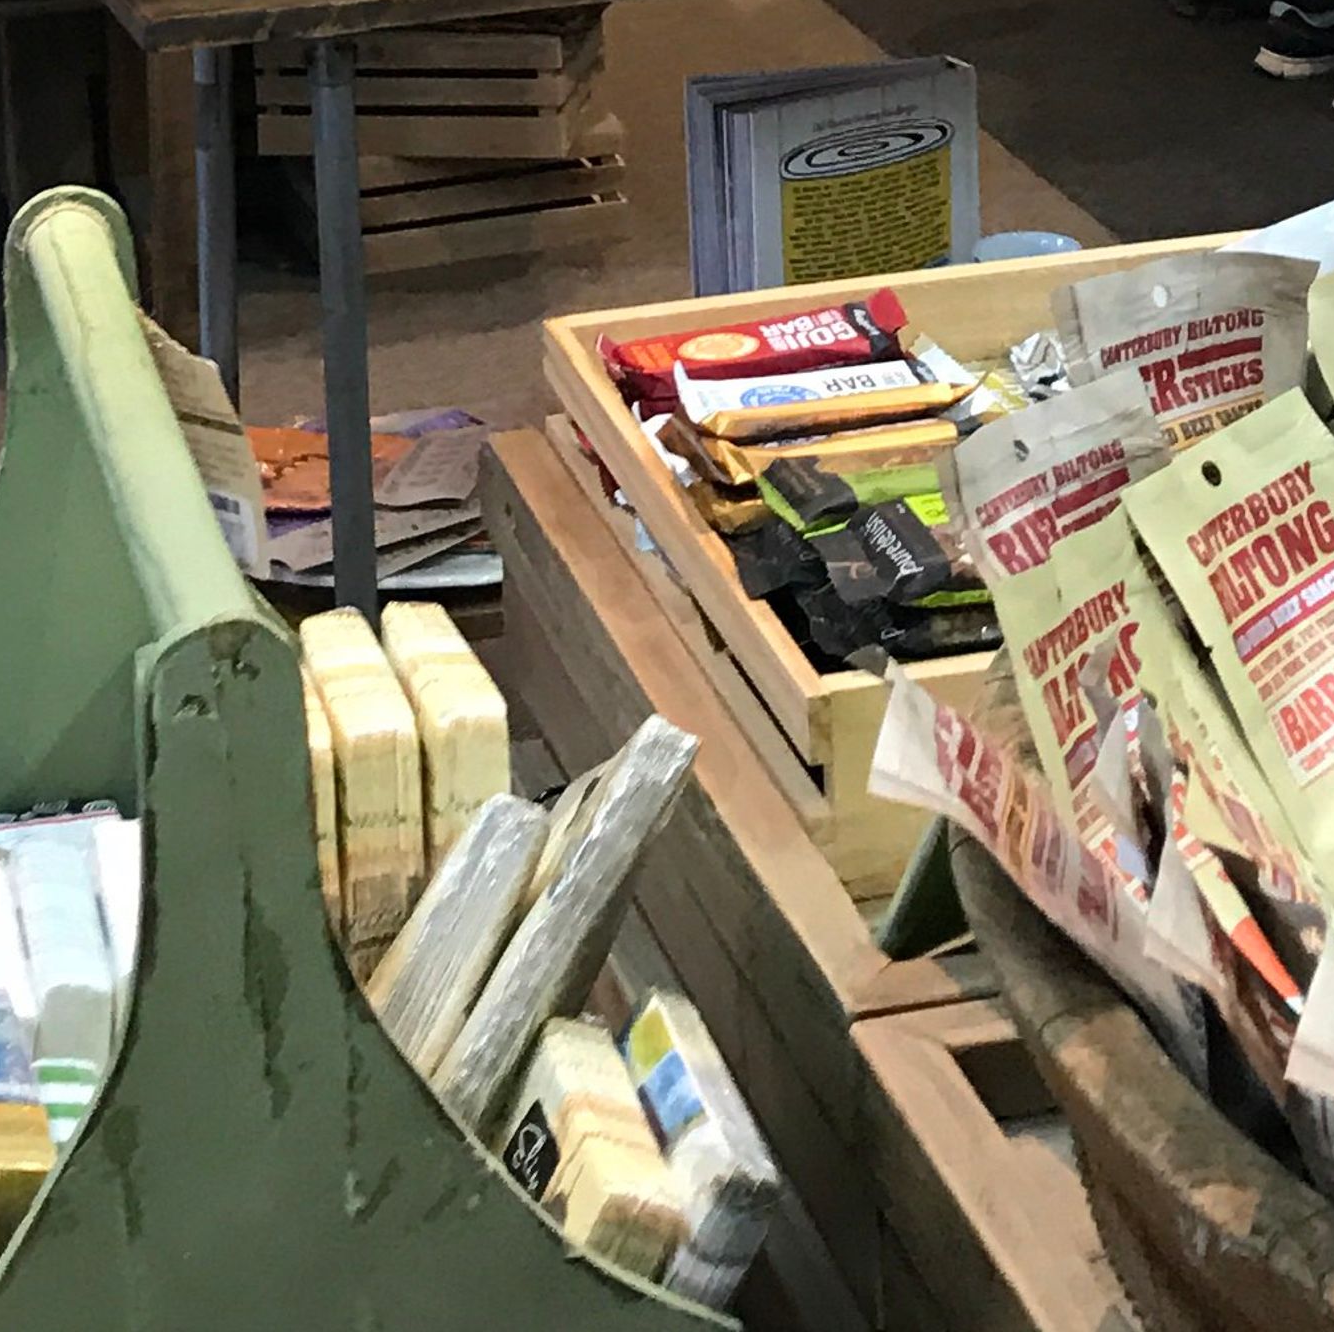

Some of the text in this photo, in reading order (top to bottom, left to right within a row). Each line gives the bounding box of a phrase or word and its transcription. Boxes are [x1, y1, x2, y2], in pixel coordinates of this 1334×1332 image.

[784, 320, 859, 351] GOJI
[1187, 309, 1265, 341] BILTONG
[826, 373, 876, 393] BAR
[1181, 358, 1265, 403] STICKS
